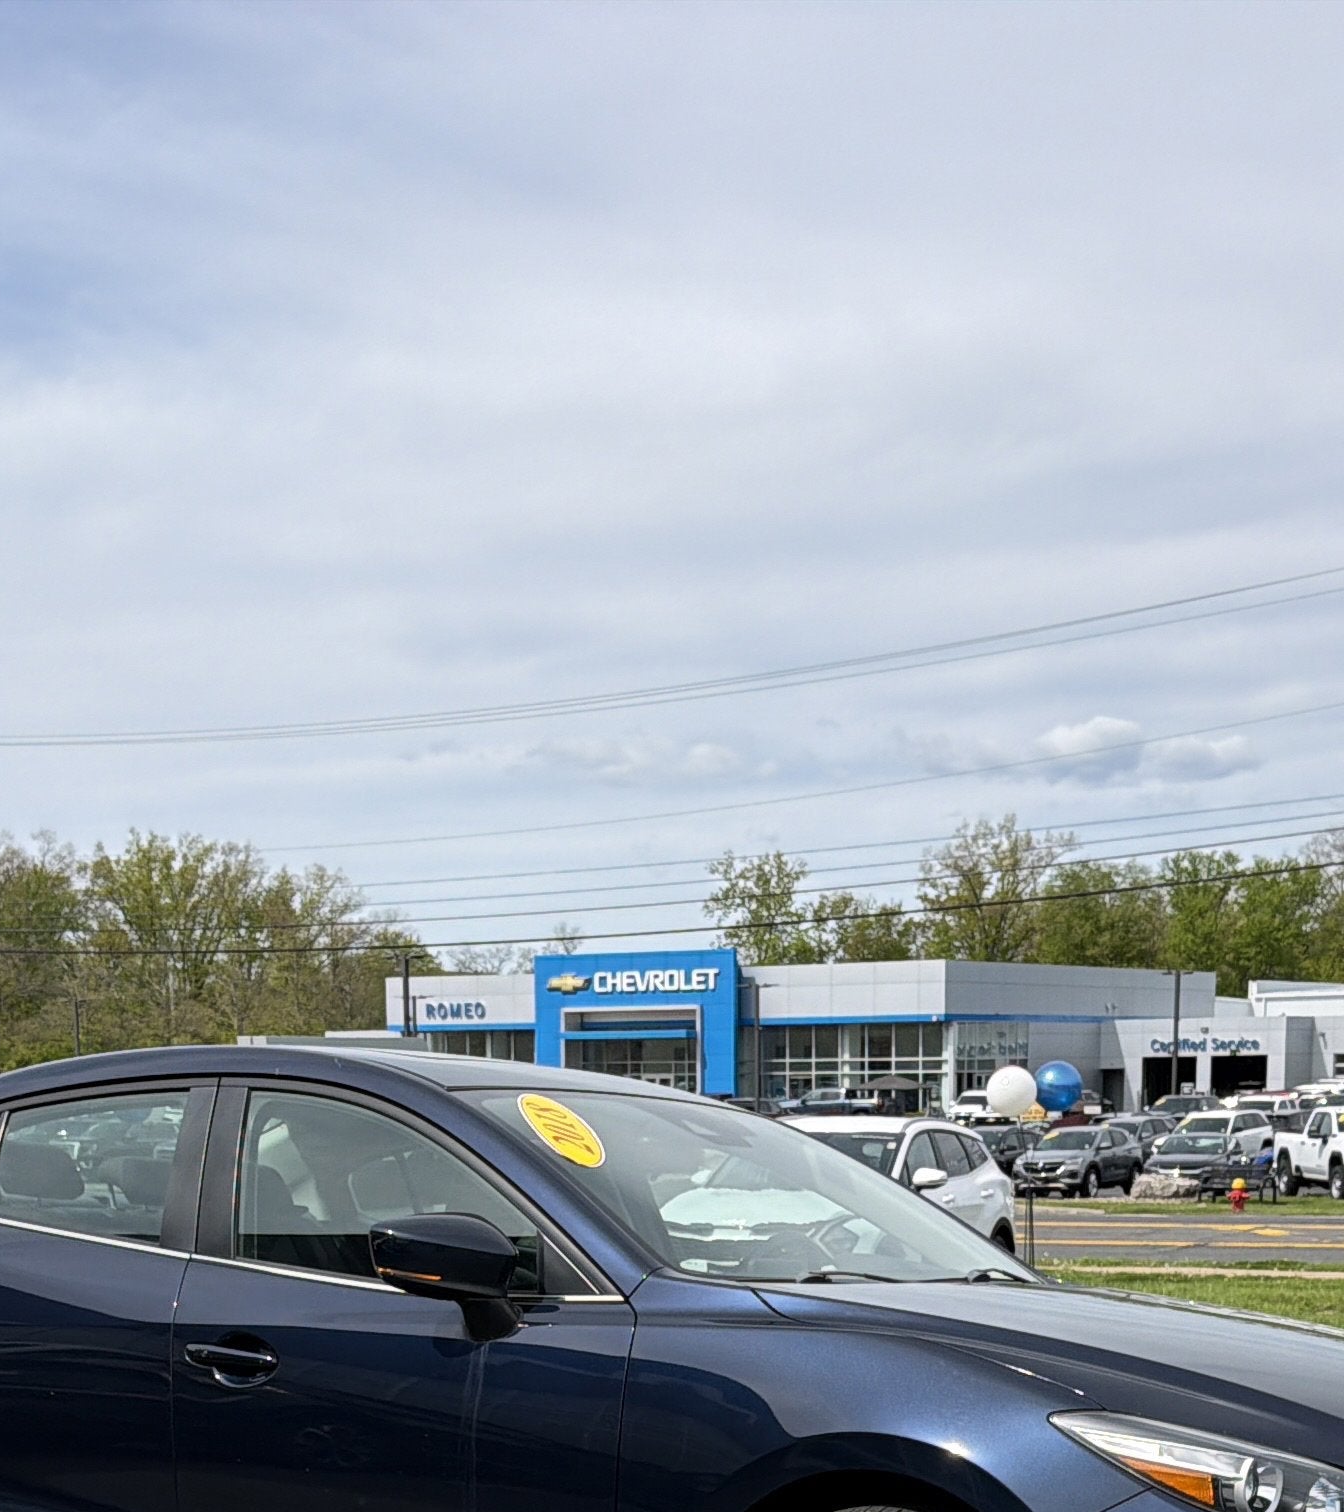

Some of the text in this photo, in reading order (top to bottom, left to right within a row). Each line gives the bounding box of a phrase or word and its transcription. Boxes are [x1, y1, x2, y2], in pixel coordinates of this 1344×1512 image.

[593, 968, 720, 994] CHEVROLET
[425, 1003, 486, 1020] ROMEO
[1150, 1037, 1260, 1053] Cerified Service
[525, 1101, 595, 1156] 2018
